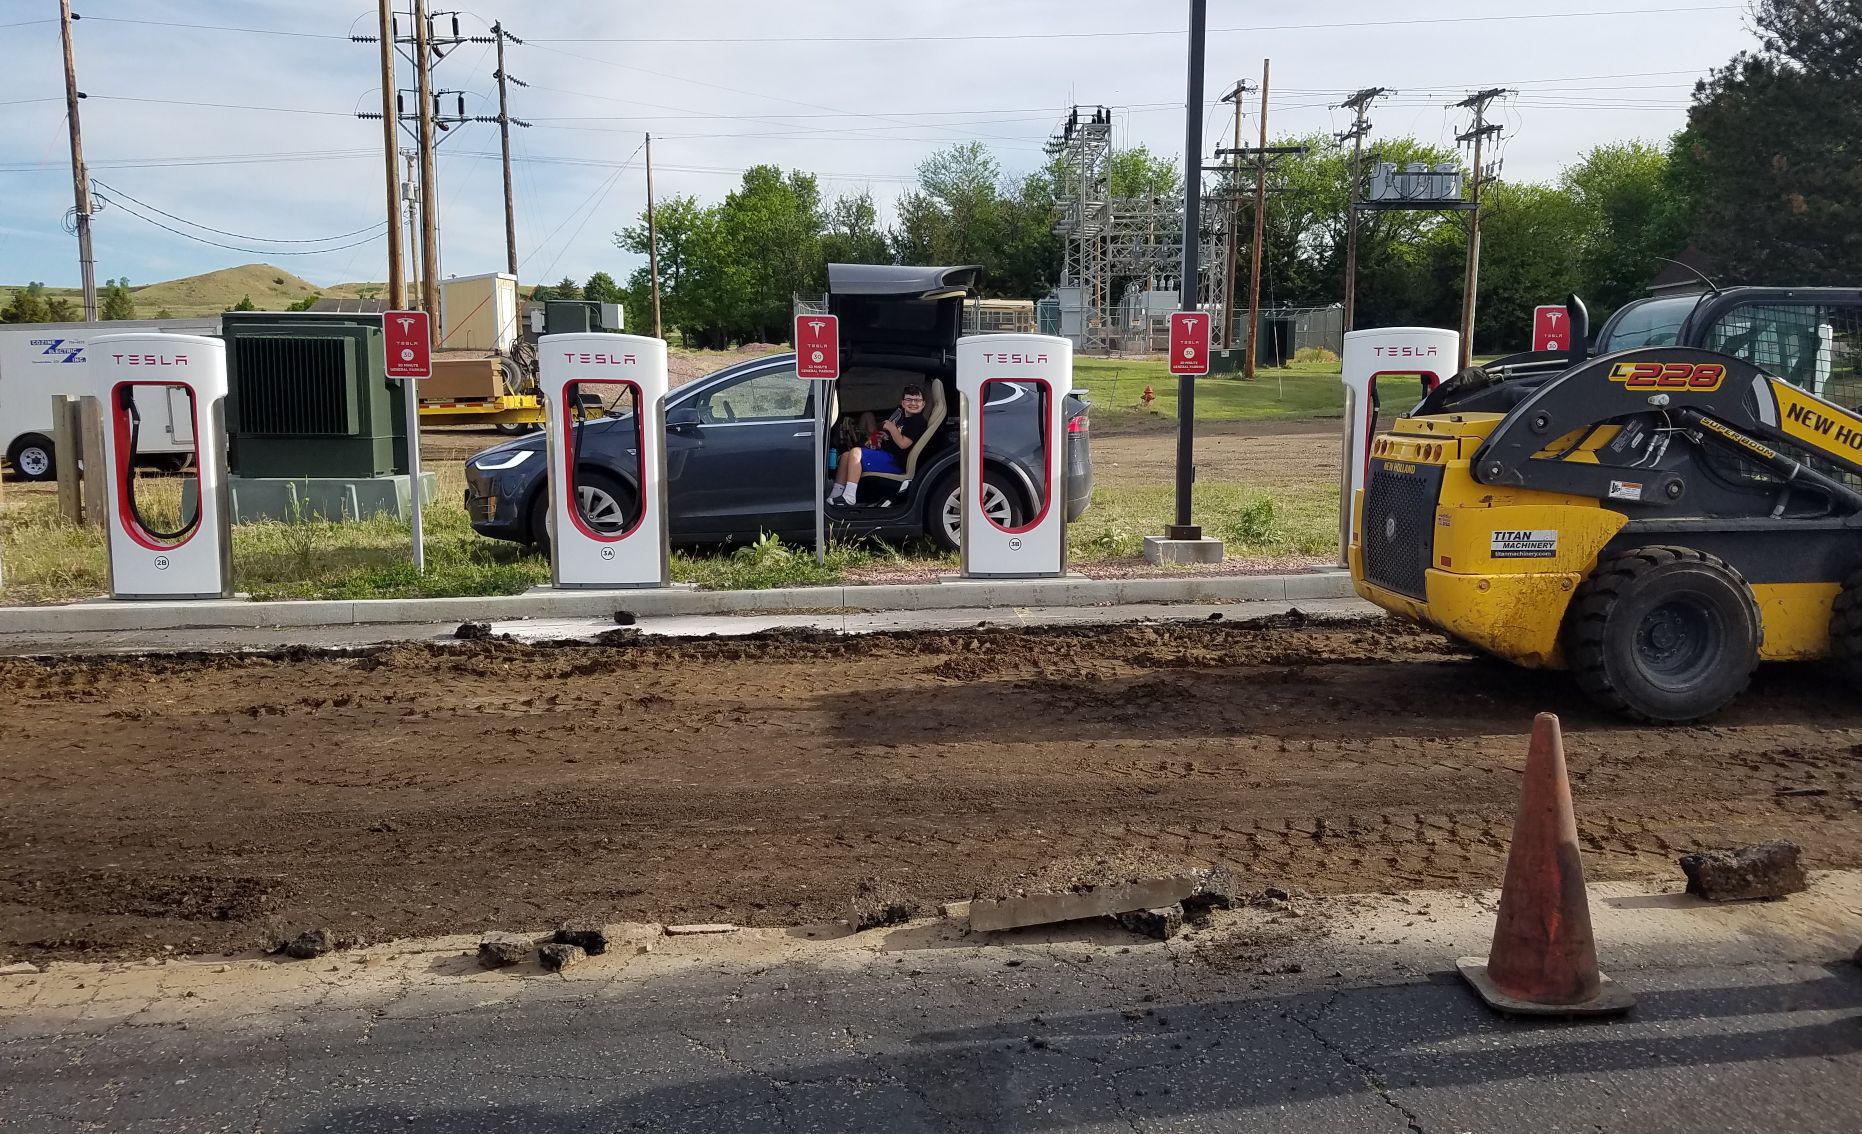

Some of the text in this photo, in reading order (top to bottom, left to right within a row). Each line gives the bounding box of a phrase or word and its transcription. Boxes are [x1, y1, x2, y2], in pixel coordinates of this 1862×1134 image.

[1373, 346, 1437, 357] TESLA
[112, 354, 188, 366] TESLA
[564, 353, 636, 365] TESLA
[982, 353, 1048, 364] TESLA
[1609, 363, 1727, 391] L228
[1786, 402, 1835, 435] NEW
[1494, 531, 1532, 541] TITAN
